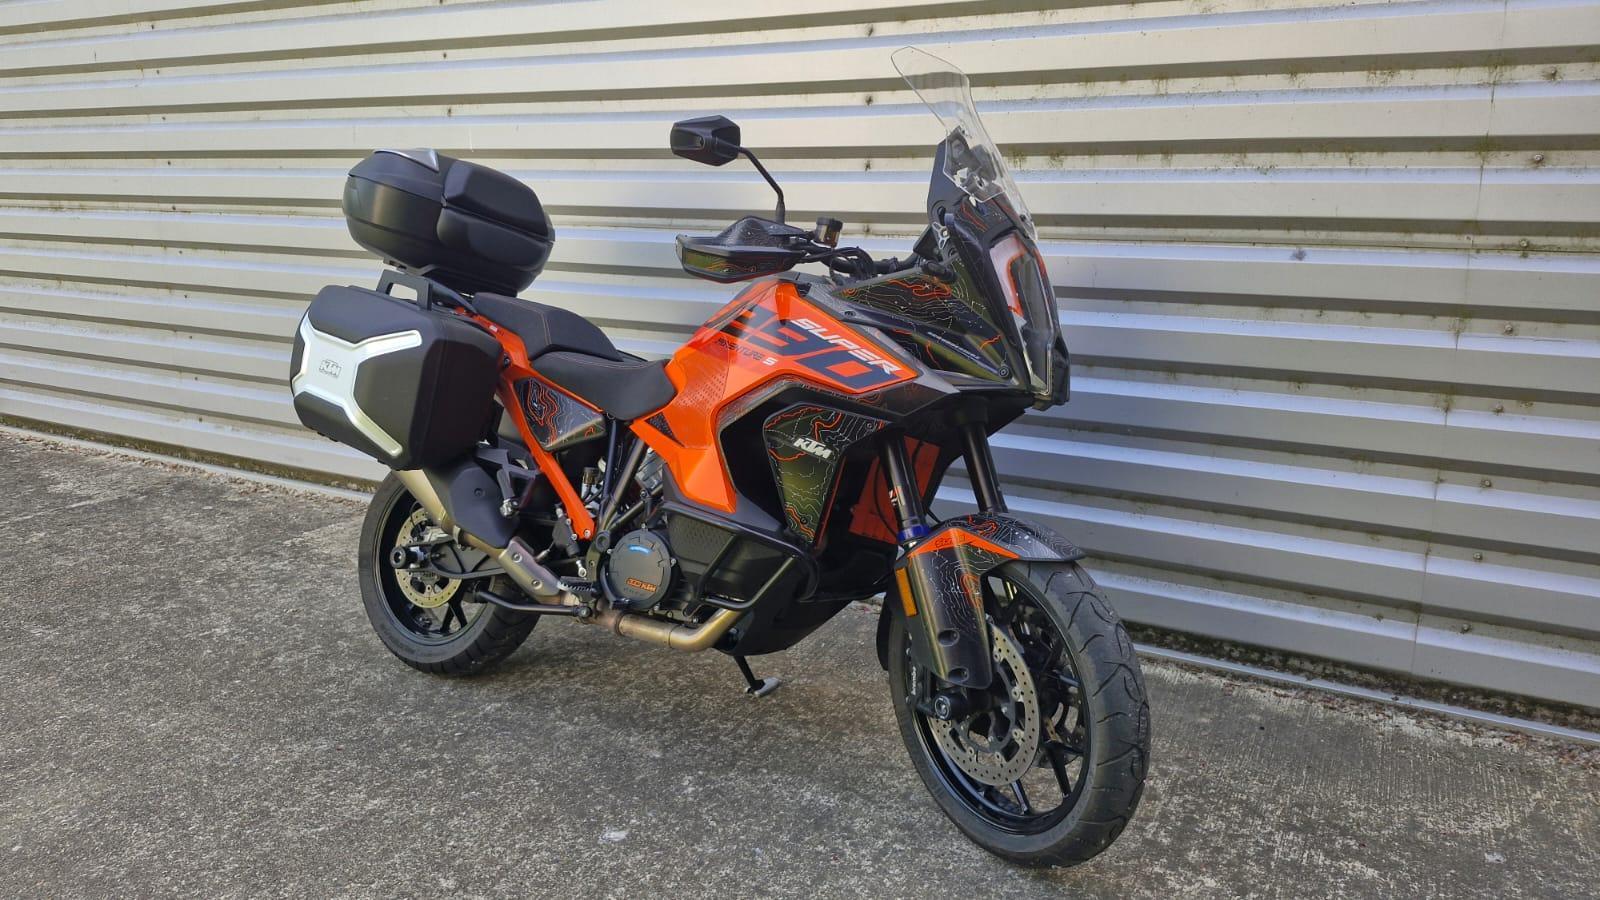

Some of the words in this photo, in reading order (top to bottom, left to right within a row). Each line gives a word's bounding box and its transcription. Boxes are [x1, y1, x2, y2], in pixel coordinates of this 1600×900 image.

[790, 317, 902, 376] SUPER
[762, 356, 779, 367] S
[793, 437, 832, 459] KTM
